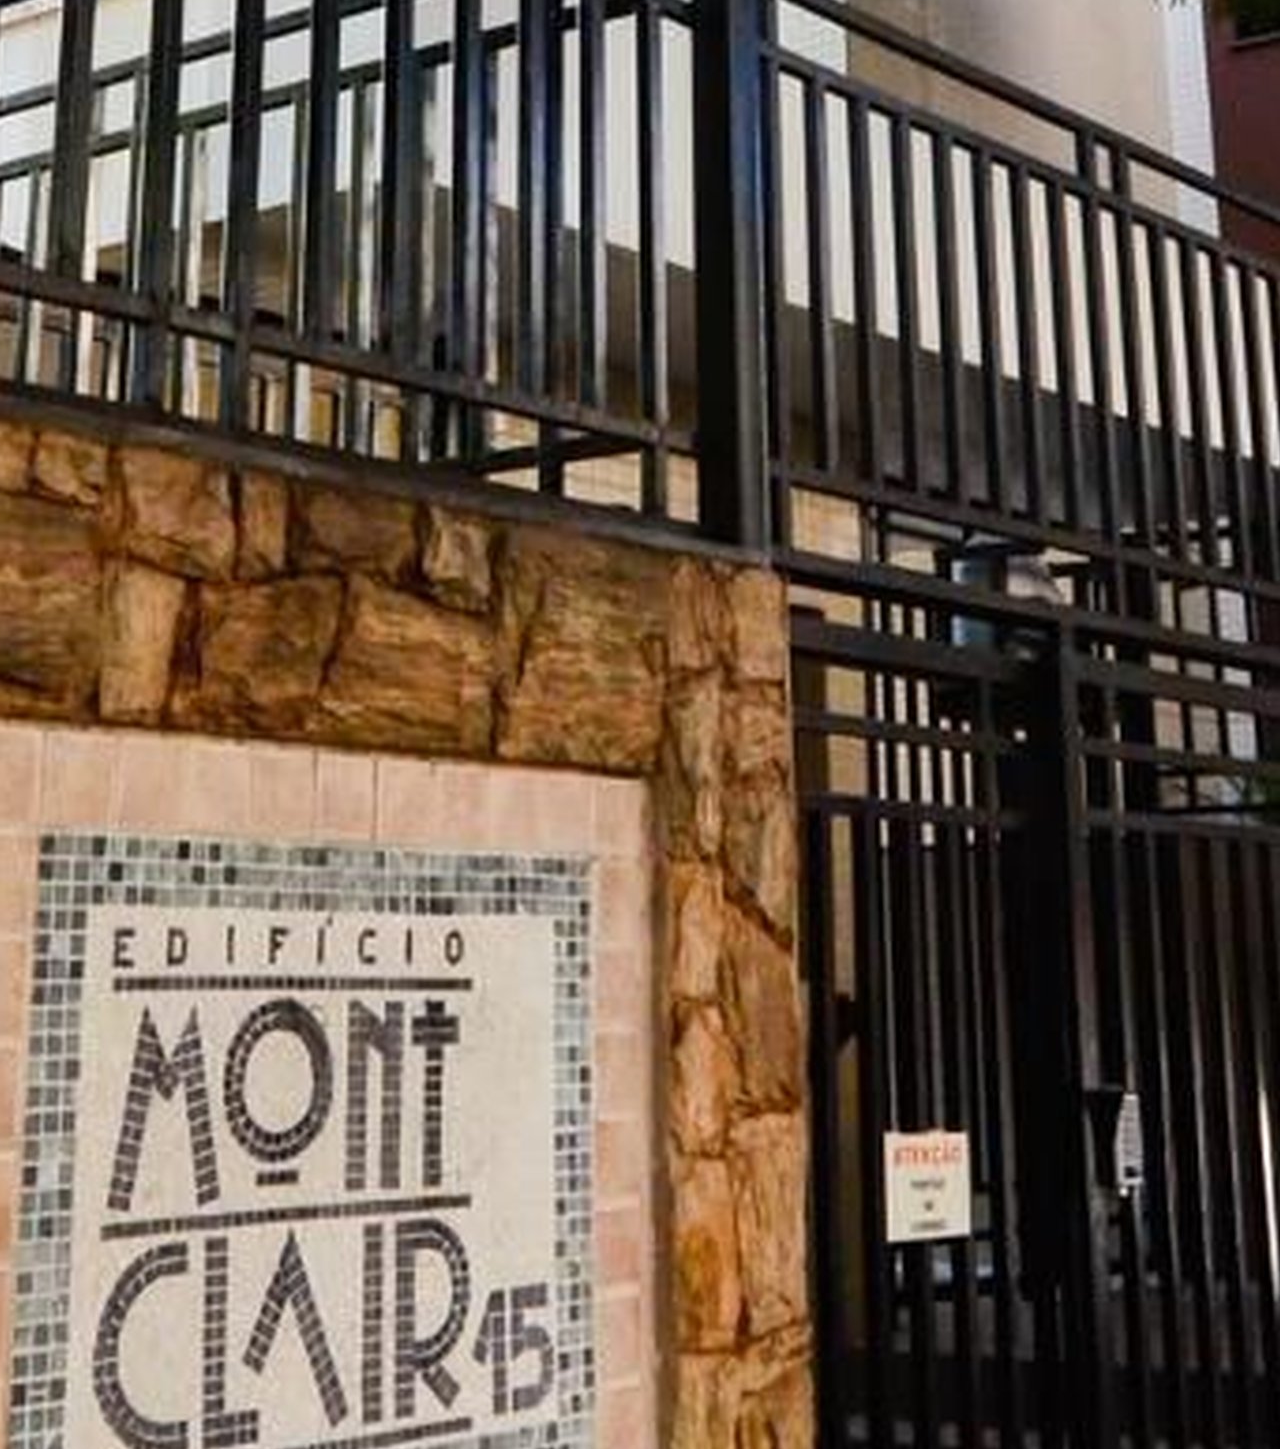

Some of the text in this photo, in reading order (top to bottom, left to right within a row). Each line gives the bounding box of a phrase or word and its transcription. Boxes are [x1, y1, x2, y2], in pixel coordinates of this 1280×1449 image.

[112, 915, 466, 969] EDIFÍCIO
[105, 995, 461, 1213] MONT
[471, 1281, 556, 1416] 15
